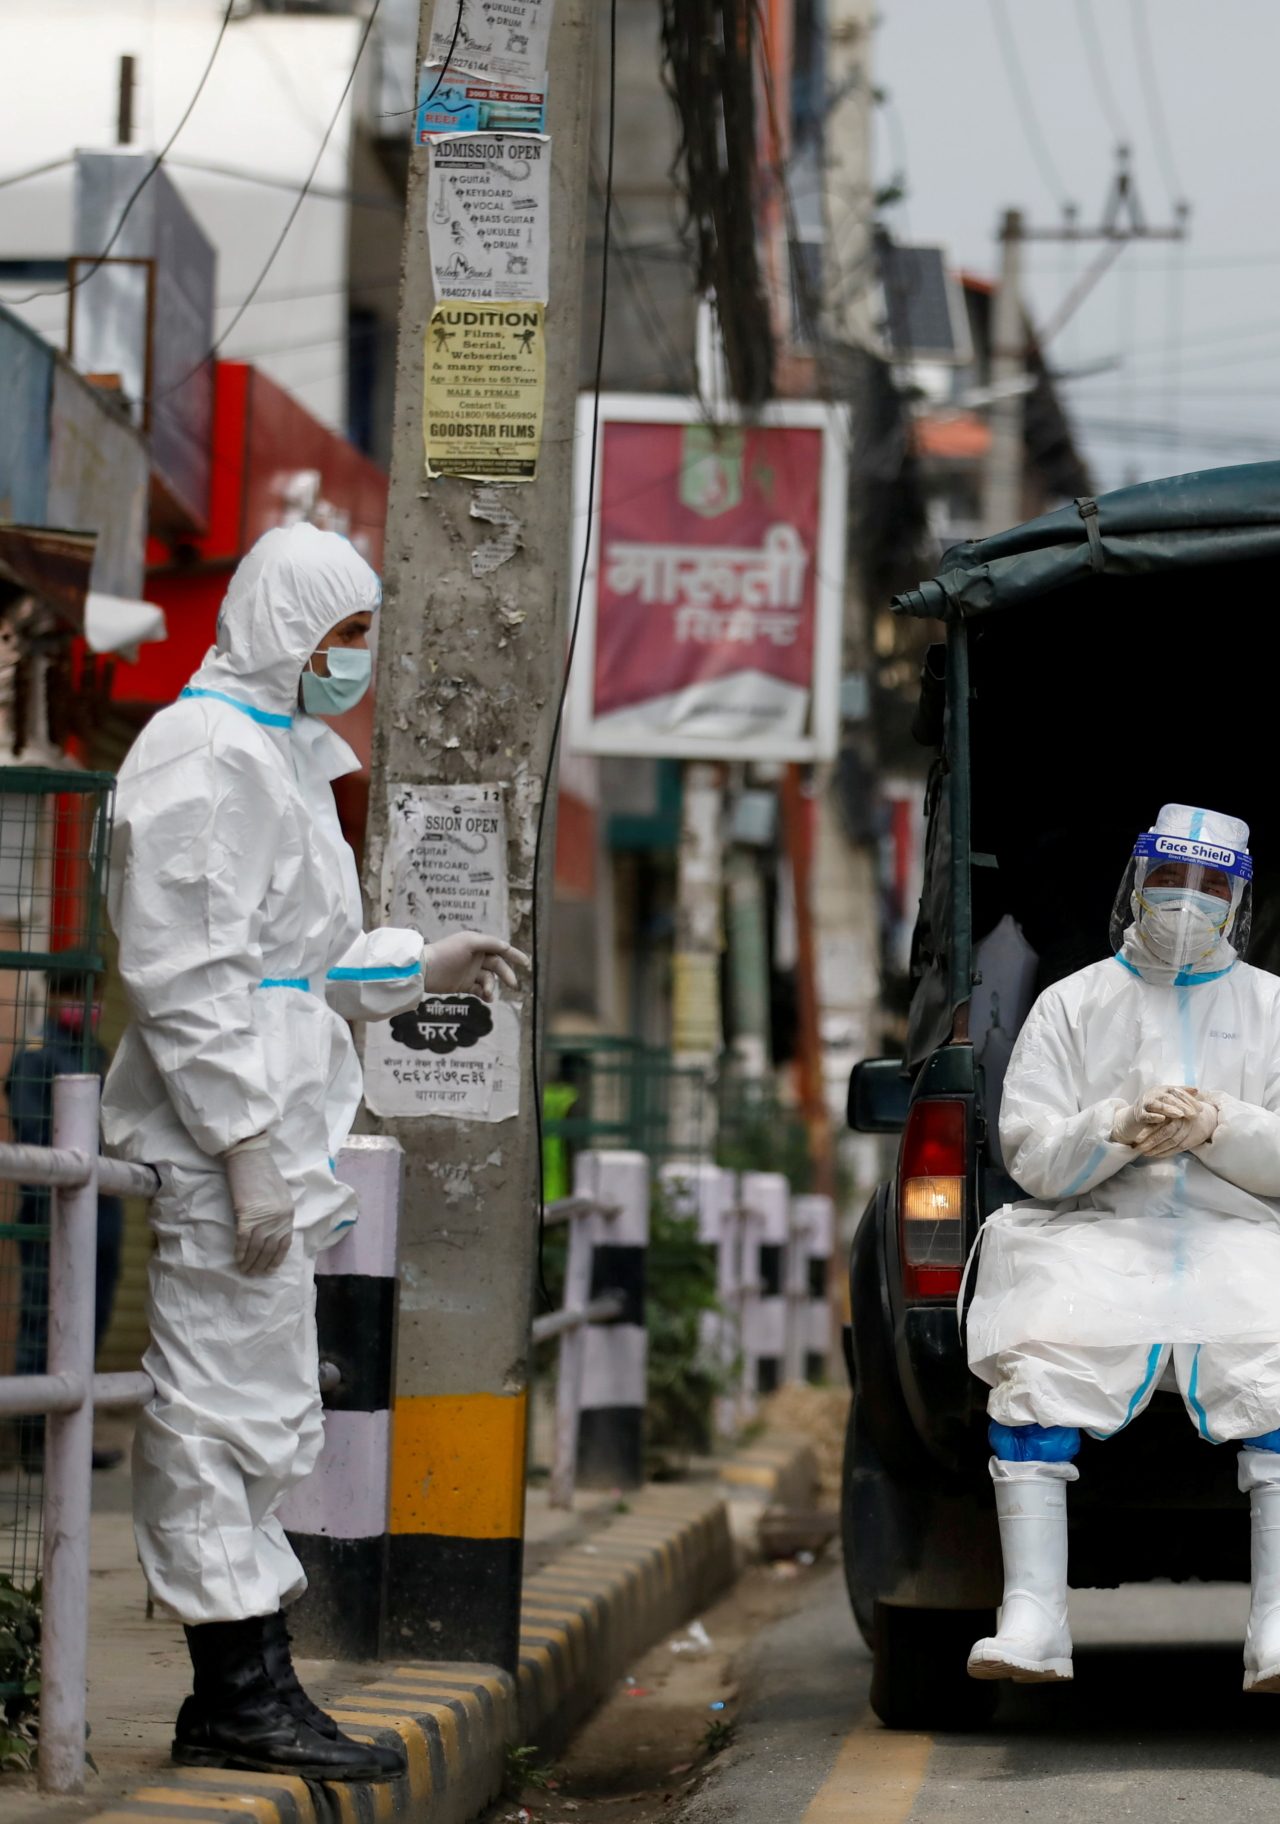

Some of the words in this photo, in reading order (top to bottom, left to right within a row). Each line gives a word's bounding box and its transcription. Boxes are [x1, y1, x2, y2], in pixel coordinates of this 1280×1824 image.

[492, 3, 526, 16] UKULELE
[496, 17, 522, 27] DRUM
[435, 143, 504, 159] ADMISSION
[508, 145, 541, 160] OPEN
[459, 176, 490, 184] GUITAR
[465, 189, 513, 198] KEYBOARD
[473, 202, 505, 210] VOCAL
[479, 215, 500, 223] BASS
[503, 216, 535, 224] GUITAR
[486, 228, 520, 237] UKULELE
[493, 241, 518, 249] DRUM
[431, 311, 538, 327] AUDITION
[464, 329, 505, 339] Films,
[463, 341, 506, 350] Serial,
[451, 352, 518, 360] Webseries
[432, 362, 442, 370] &
[447, 363, 483, 373] many
[430, 423, 496, 437] GOODSTAR
[500, 425, 535, 438] FILMS
[425, 815, 462, 831] SSION
[466, 818, 498, 833] OPEN
[416, 848, 447, 856] GUITAR
[1160, 840, 1188, 853] Face
[1192, 845, 1232, 863] Shield
[422, 861, 469, 870] KEYBOARD
[429, 874, 460, 882] VOCAL
[436, 887, 456, 895] BASS
[459, 888, 490, 896] GUITAR
[441, 901, 476, 909] UKULELE
[448, 913, 473, 921] DRUM
[426, 1001, 469, 1016] महिनामा
[417, 1022, 460, 1041] फरर
